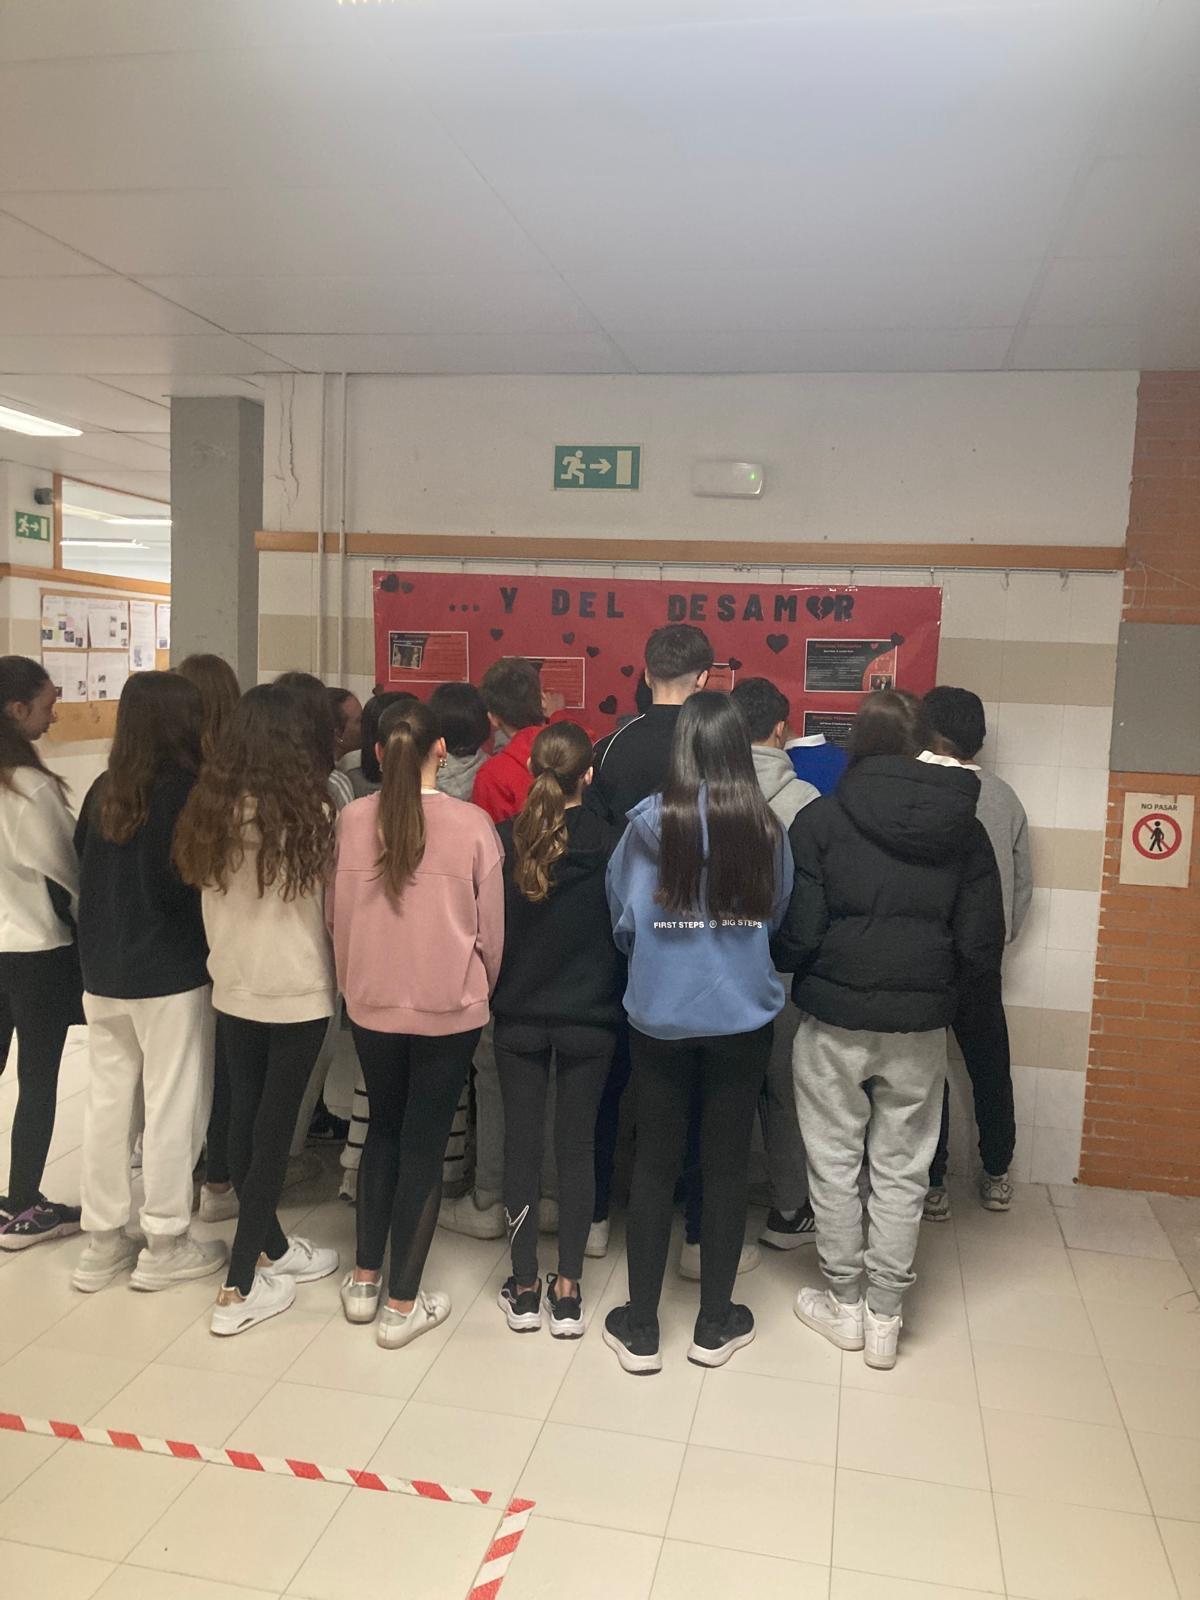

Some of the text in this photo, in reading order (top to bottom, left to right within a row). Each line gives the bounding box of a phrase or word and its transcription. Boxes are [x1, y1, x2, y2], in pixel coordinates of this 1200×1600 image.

[499, 586, 519, 614] Y
[551, 588, 624, 619] DEL
[1154, 803, 1178, 811] PASAR
[653, 921, 677, 929] FIRST
[678, 921, 705, 929] STEPS
[737, 918, 763, 929] STEPS
